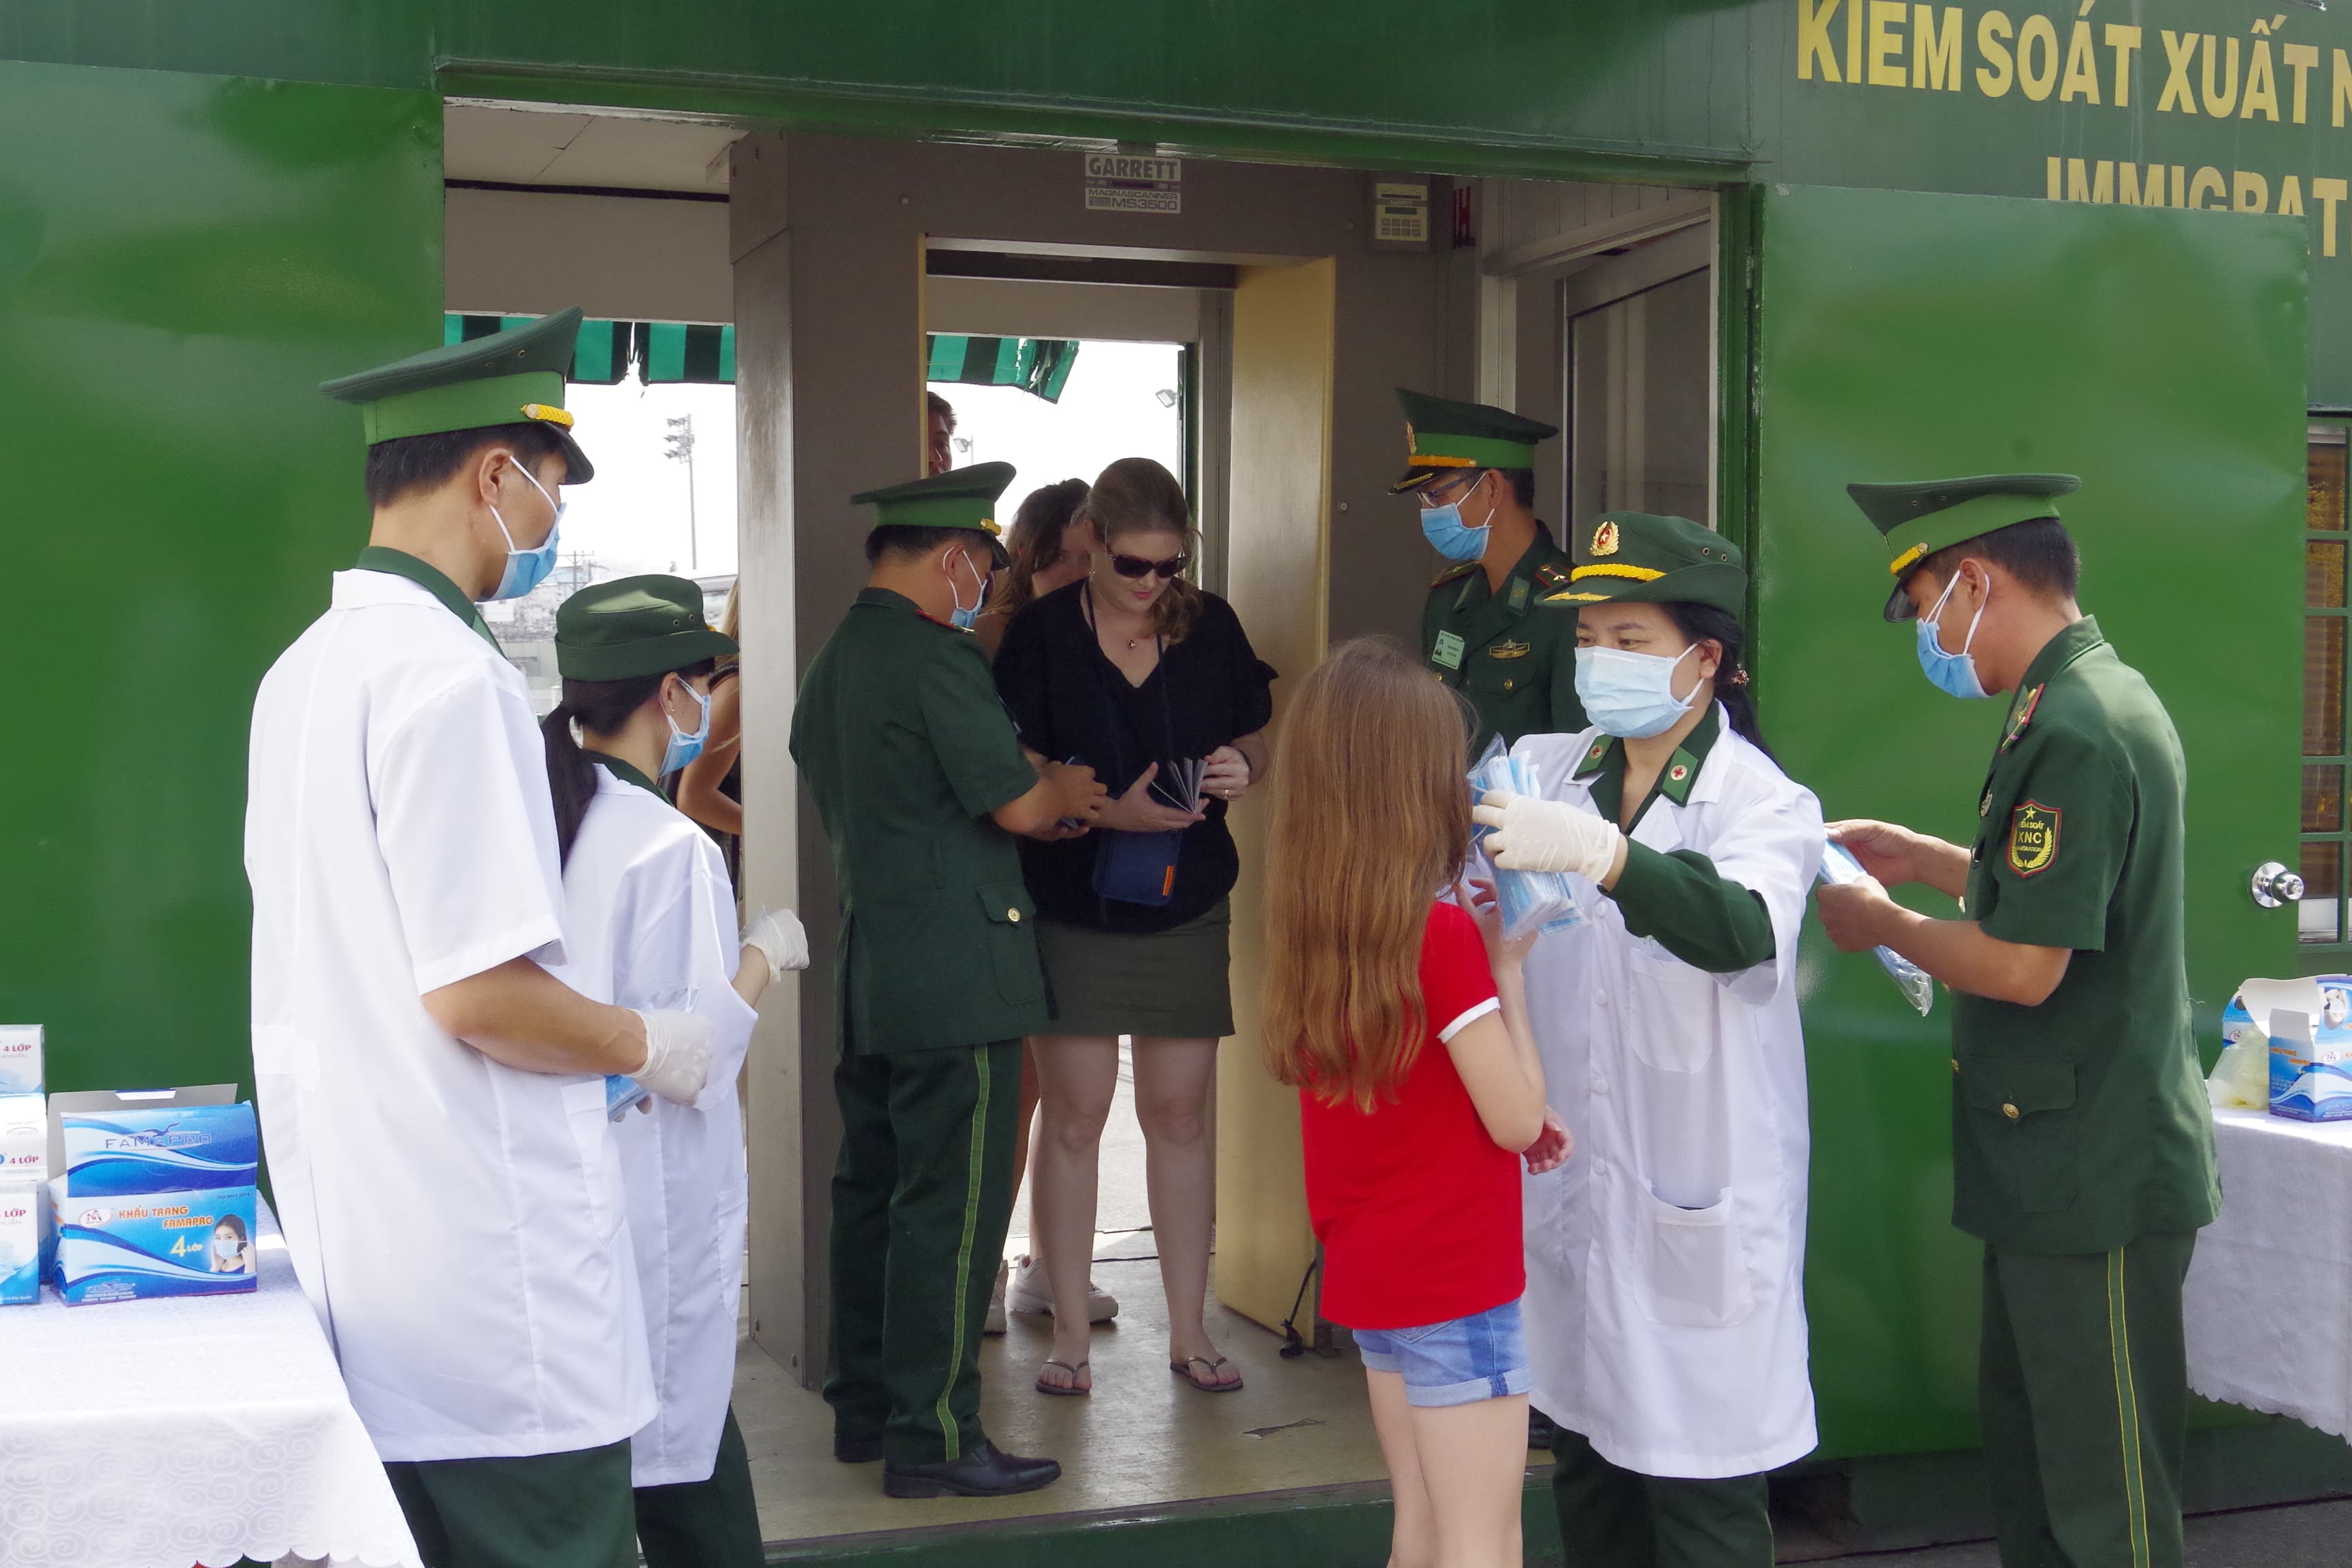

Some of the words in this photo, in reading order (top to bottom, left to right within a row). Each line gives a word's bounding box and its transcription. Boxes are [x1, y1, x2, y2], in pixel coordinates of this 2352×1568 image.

[1975, 0, 2142, 108] SOÁT
[2156, 14, 2319, 125] XUẤT
[1089, 157, 1177, 180] GARRETT
[1089, 189, 1177, 200] MAGNASCANNER
[1111, 198, 1177, 211] MS3500
[2018, 832, 2042, 844] XNC
[105, 1134, 212, 1149] FAMAPRO
[152, 1206, 189, 1217] TRANG
[163, 1215, 214, 1228] FAMAPRO
[169, 1235, 186, 1258] 4
